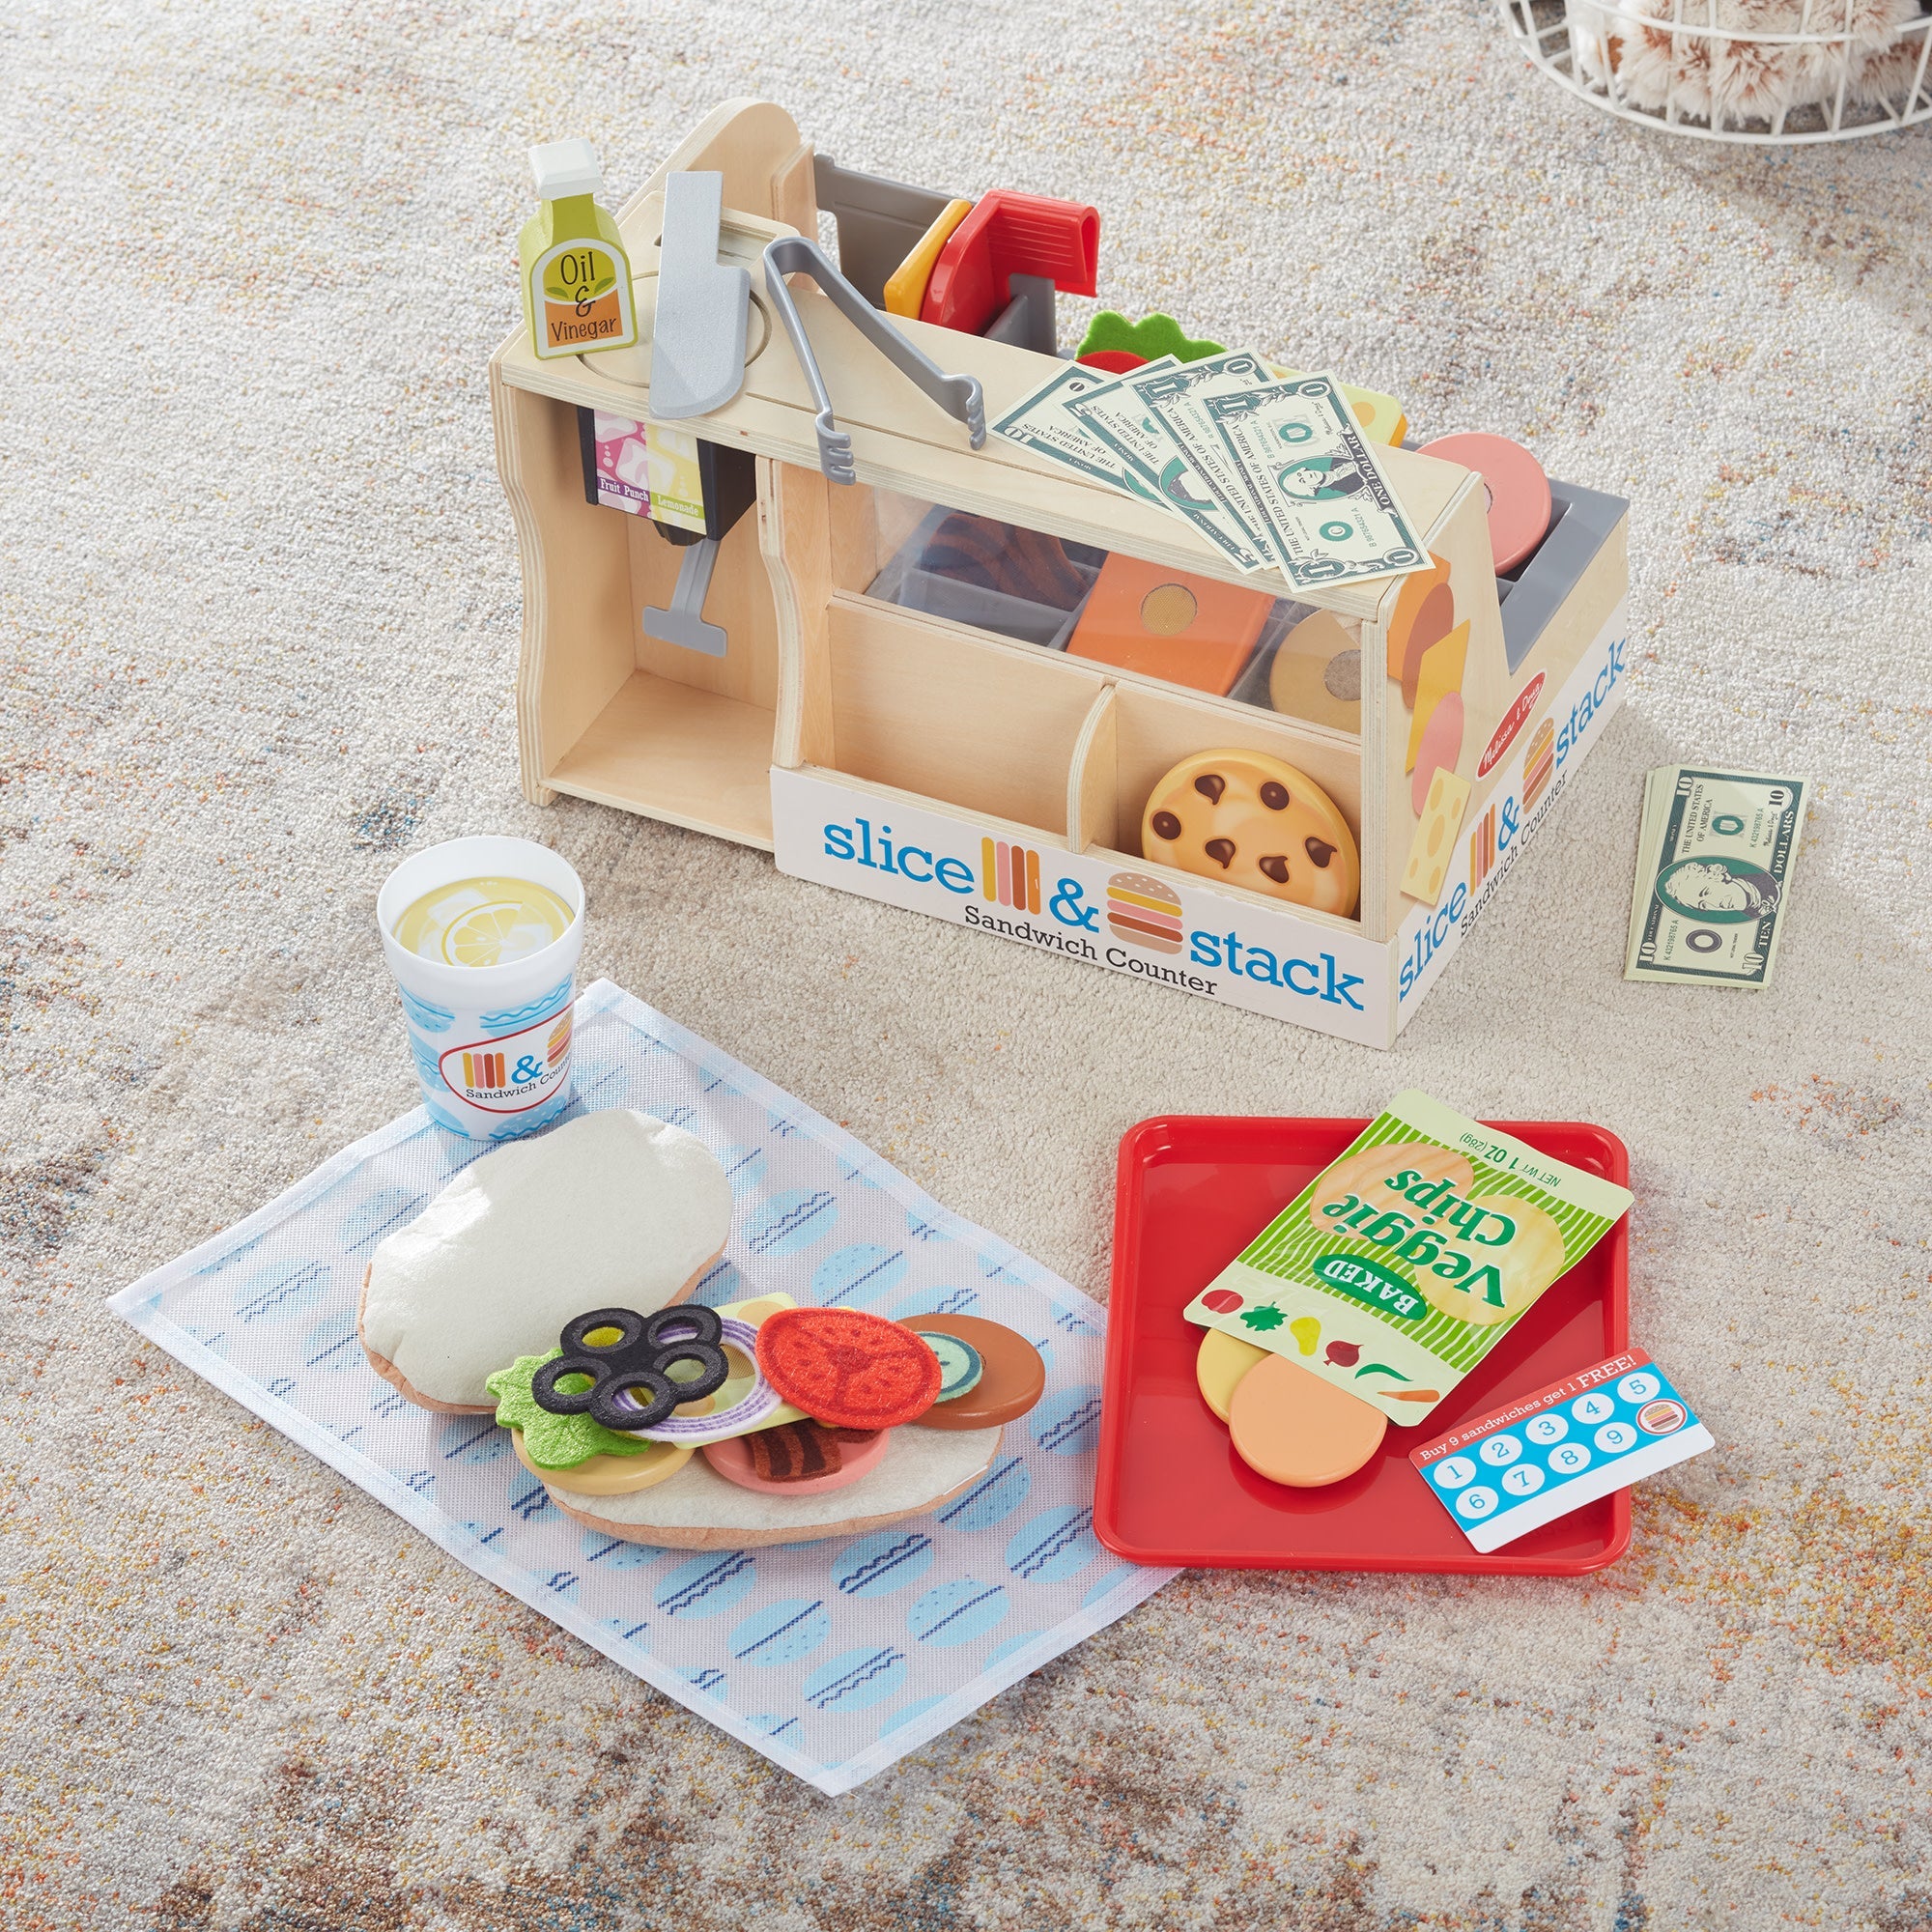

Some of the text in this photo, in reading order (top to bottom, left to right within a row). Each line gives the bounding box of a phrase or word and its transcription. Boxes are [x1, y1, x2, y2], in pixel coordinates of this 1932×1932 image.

[560, 251, 595, 285] Oil
[575, 285, 596, 317] &
[551, 318, 616, 341] Vinegar
[1048, 425, 1106, 455] OF AMERICA
[1090, 405, 1159, 466] THE UNITED STATES
[1114, 412, 1158, 449] OF AMERICA
[1166, 407, 1196, 443] AMERICA
[1022, 423, 1116, 469] THE UNITED STATES
[1192, 441, 1207, 455] OF
[1202, 454, 1230, 485] STATES
[1347, 436, 1391, 505] ONE DOLLAR
[600, 478, 649, 501] Fruit Punch
[657, 495, 698, 516] Lemonade
[1225, 483, 1251, 515] UNITED
[1232, 424, 1304, 556] THE UNITED STATES OF AMERICA
[1676, 777, 1693, 798] 10
[1768, 789, 1785, 808] 10
[1399, 638, 1626, 1003] slice & stack
[1682, 783, 1704, 854] THE UNITED STATES
[1696, 799, 1713, 842] OF AMERICA
[1461, 769, 1567, 938] Sandwich Counter
[1758, 810, 1794, 949] TEN DOLLARS
[824, 817, 1365, 1011] slice & stack
[964, 905, 1218, 996] Sandwich Counter
[1639, 941, 1657, 962] 10
[1742, 952, 1765, 971] 10
[511, 1055, 543, 1084] &
[466, 1082, 536, 1099] Sandwich
[1460, 1132, 1488, 1151] (28g)
[1484, 1145, 1507, 1163] OZ
[1508, 1157, 1520, 1170] 1
[1537, 1172, 1561, 1187] NET
[1383, 1168, 1517, 1246] Chips
[1321, 1194, 1506, 1309] Veggie
[1323, 1260, 1419, 1316] BAKED
[1419, 1354, 1637, 1461] Buy 9 sandwiches get 1 FREE!
[1447, 1378, 1647, 1481] 1 2 3 4 5
[1469, 1430, 1623, 1509] 6 7 8 9
